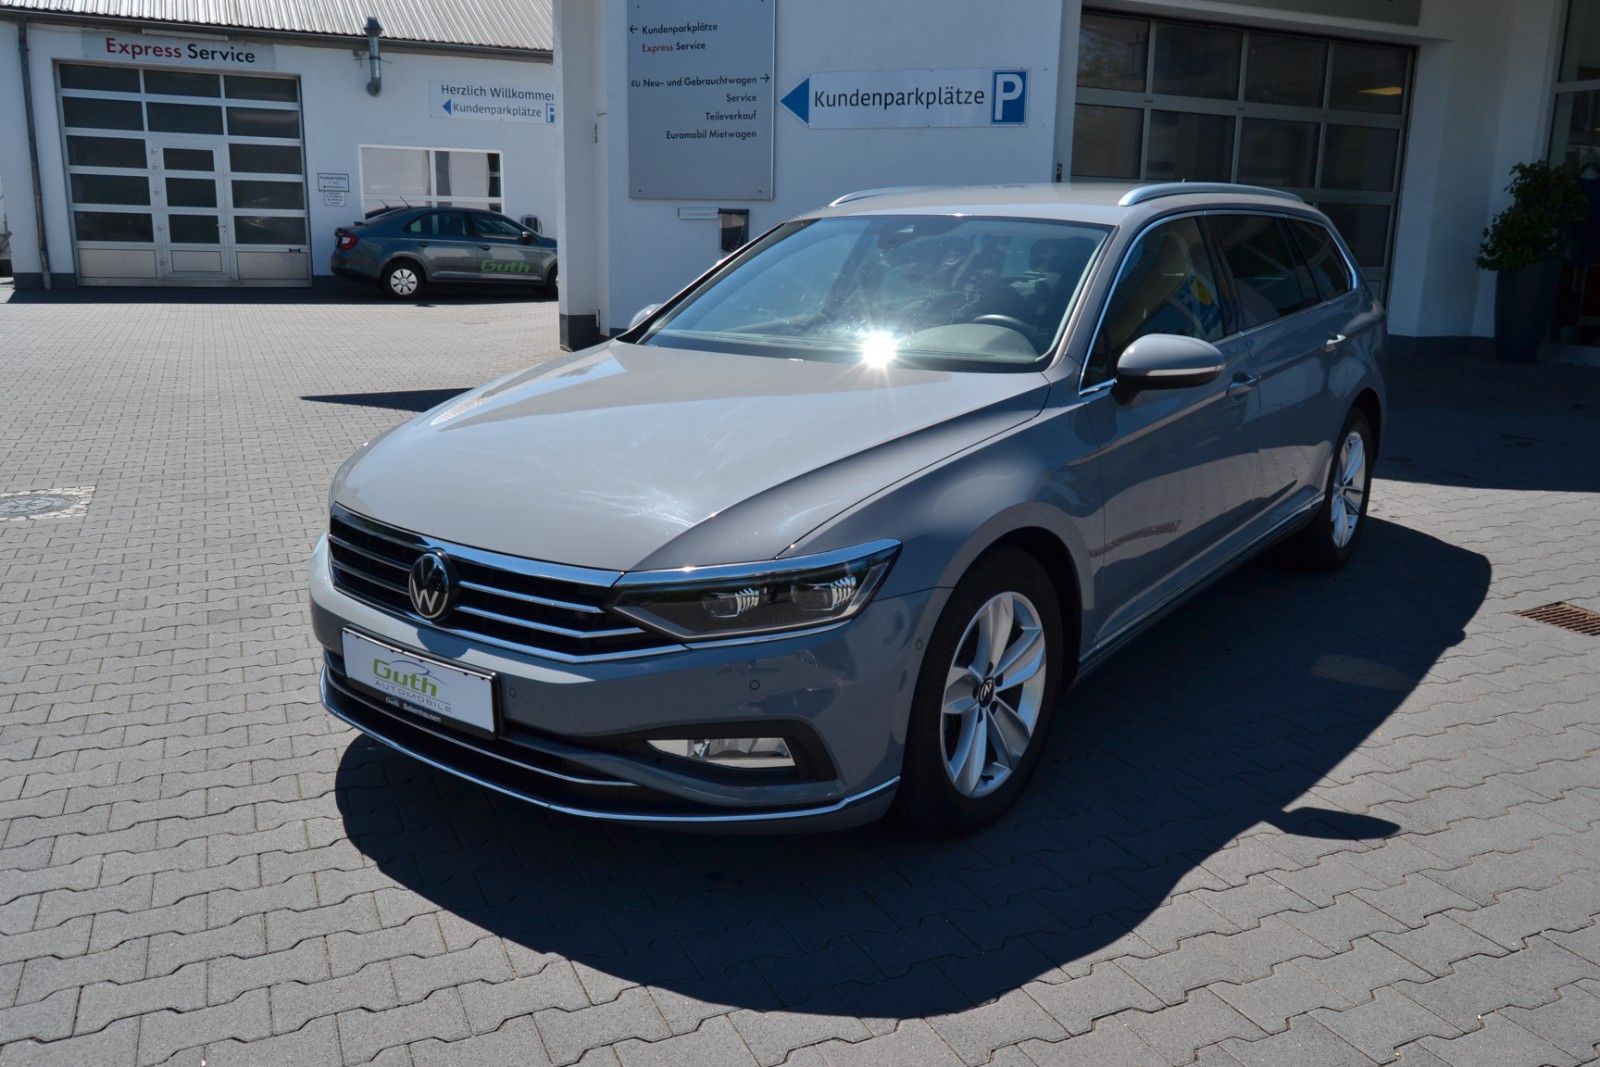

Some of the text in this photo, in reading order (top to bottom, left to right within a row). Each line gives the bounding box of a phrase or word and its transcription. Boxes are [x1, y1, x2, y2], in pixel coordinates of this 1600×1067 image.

[642, 22, 718, 35] Kundenparkplätze
[106, 37, 255, 63] Express Service
[642, 41, 706, 54] Express Service
[667, 77, 682, 86] und
[684, 76, 757, 86] Gebrauchtwagen
[441, 84, 486, 97] Herzlich
[726, 93, 757, 102] Service
[815, 87, 985, 110] Kundenparkplätze
[994, 74, 1023, 121] P
[453, 103, 542, 117] Kundenparkplätze
[705, 110, 757, 121] Teileverkauf
[709, 129, 757, 140] Mietwagen
[372, 658, 438, 698] Guth
[375, 680, 453, 713] AUTOMOBILE
